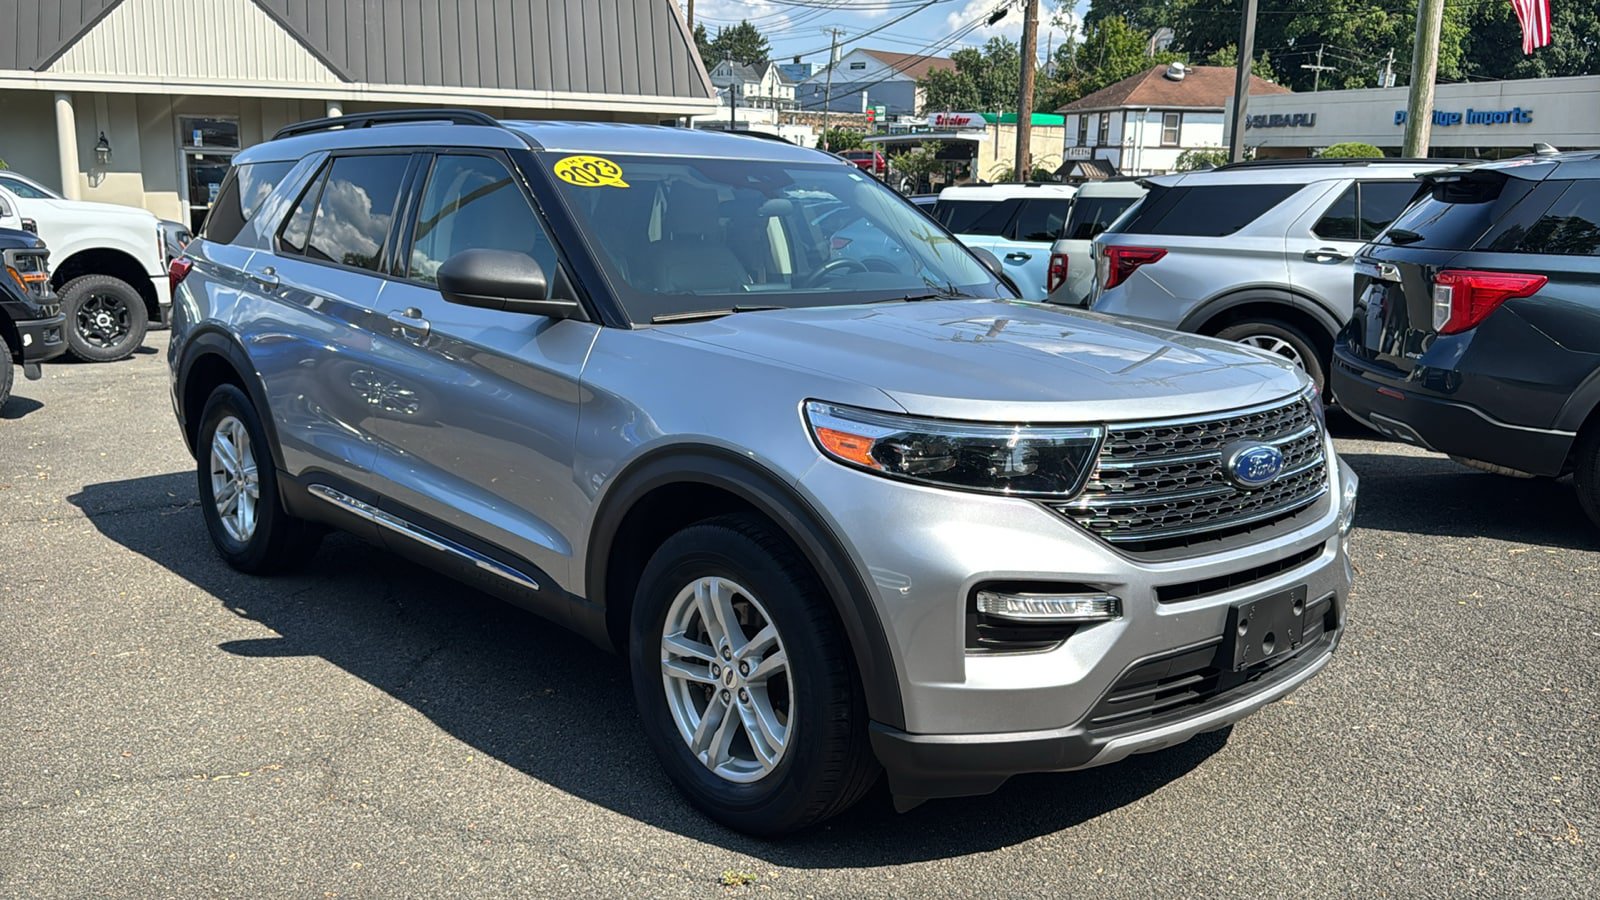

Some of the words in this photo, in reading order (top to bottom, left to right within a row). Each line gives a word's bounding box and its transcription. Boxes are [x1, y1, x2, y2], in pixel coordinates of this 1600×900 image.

[1252, 113, 1316, 128] SUBARU
[560, 160, 619, 184] 2023
[1249, 453, 1277, 478] Ford
